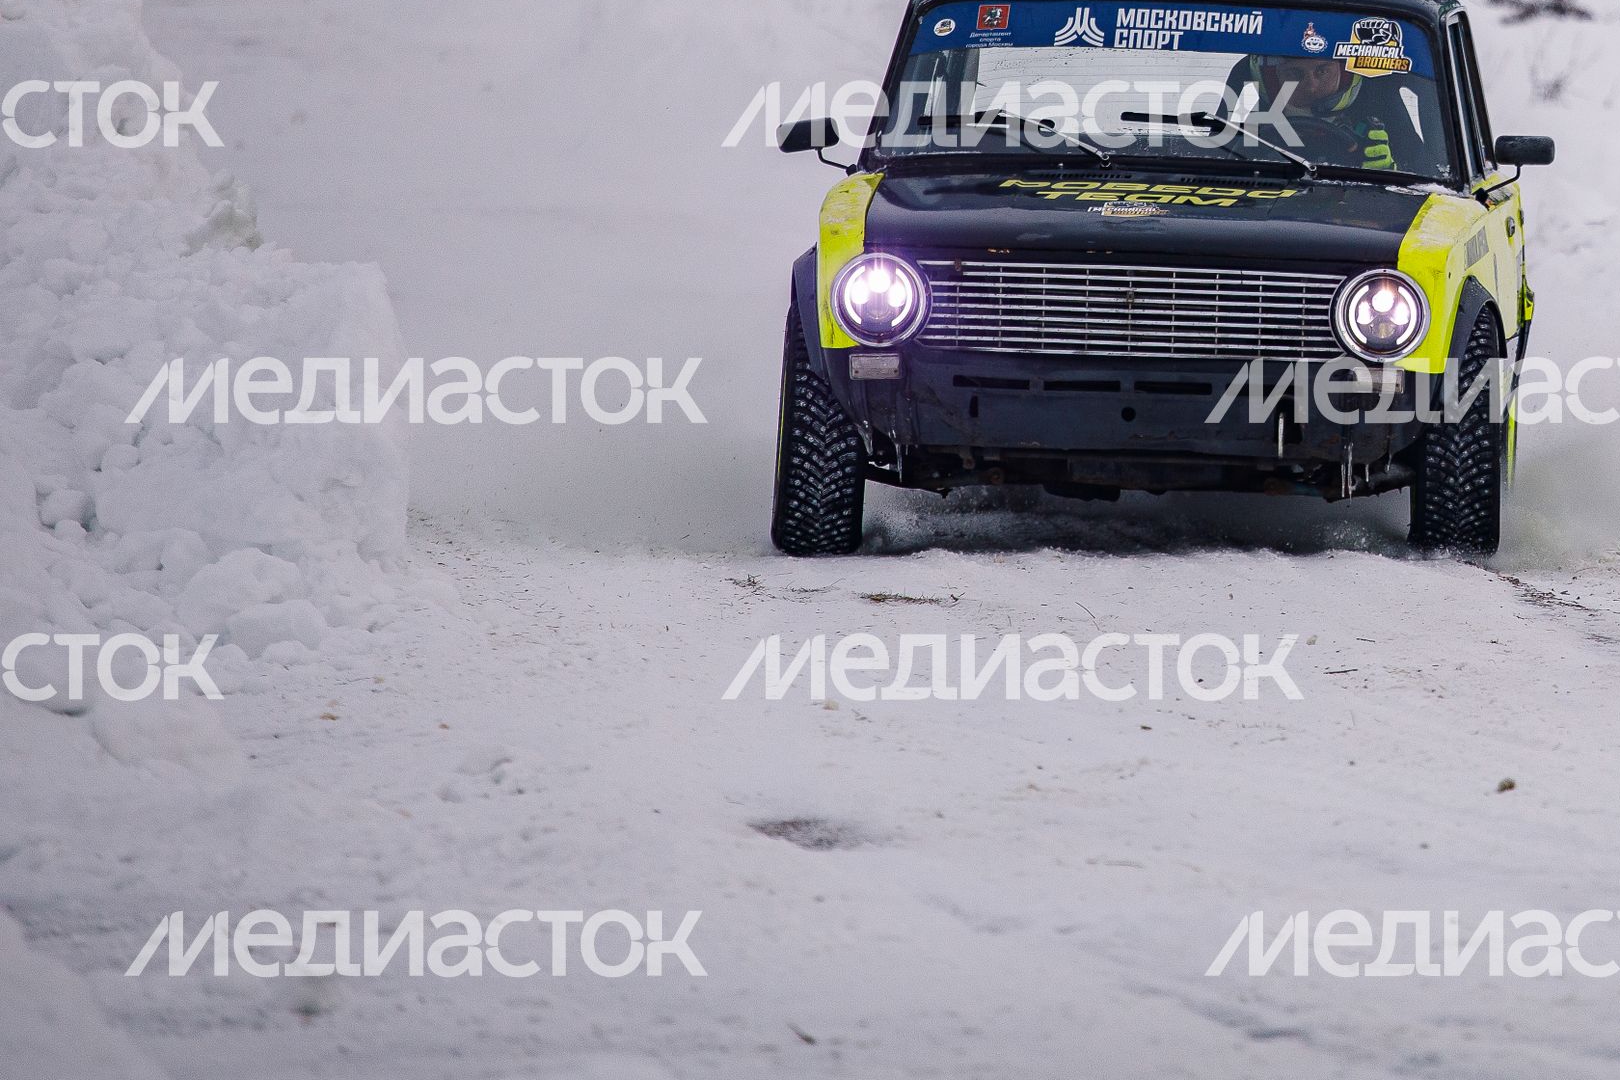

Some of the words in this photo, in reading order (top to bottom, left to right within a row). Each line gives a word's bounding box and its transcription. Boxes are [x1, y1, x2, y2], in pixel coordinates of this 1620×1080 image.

[1116, 8, 1263, 35] МОСКОВСКИЙ
[1114, 29, 1184, 50] СПОРТ
[1336, 44, 1403, 59] MECHANICAL
[1356, 56, 1409, 70] BROTHERS
[1036, 191, 1238, 207] TEAM
